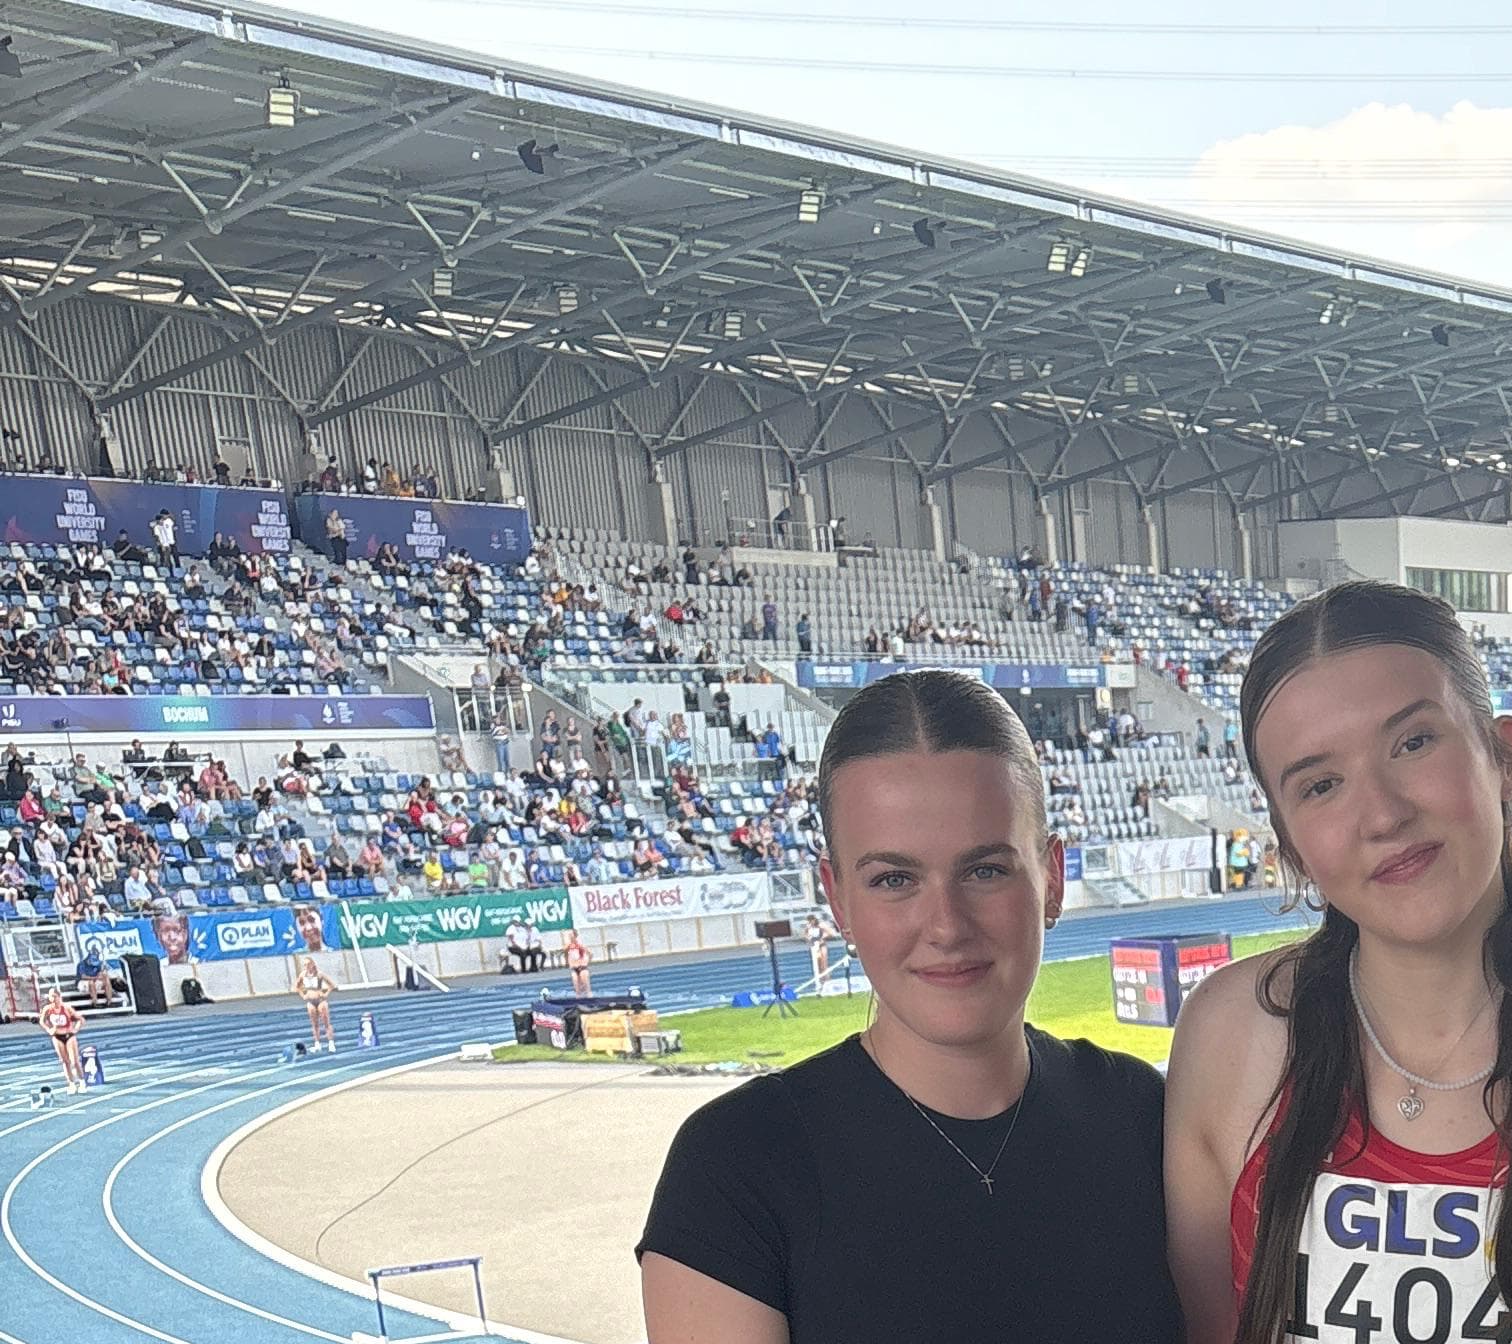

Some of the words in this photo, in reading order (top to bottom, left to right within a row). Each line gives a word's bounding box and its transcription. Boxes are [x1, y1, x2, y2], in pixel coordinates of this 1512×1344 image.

[526, 899, 568, 923] WGV
[584, 888, 631, 913] Black
[635, 885, 683, 909] Forest
[437, 904, 482, 932] WGV
[106, 934, 138, 950] PLAN
[242, 925, 269, 940] PLAN
[1324, 1184, 1480, 1259] GLS
